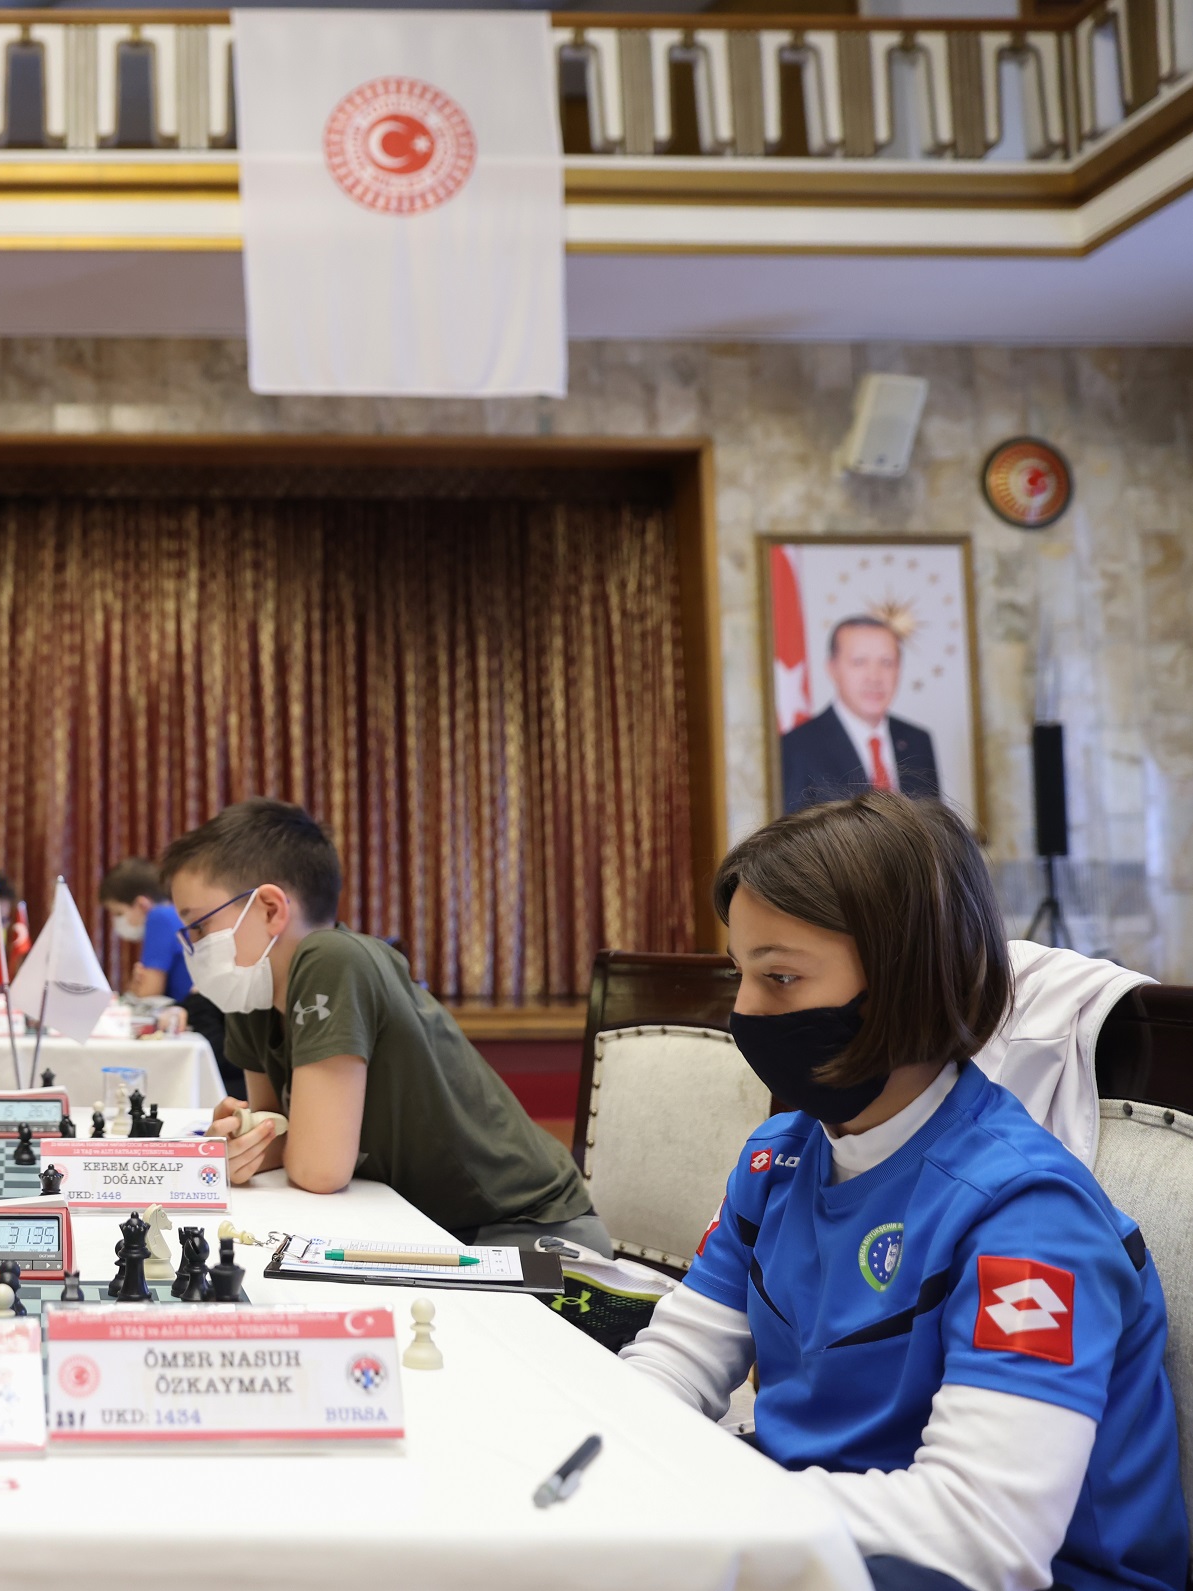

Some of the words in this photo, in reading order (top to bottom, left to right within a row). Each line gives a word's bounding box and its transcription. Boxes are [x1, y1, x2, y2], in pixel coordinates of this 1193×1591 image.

[83, 1162, 130, 1172] KEREM
[132, 1160, 184, 1172] GÖKALP
[103, 1174, 165, 1185] DOĞANAY
[68, 1191, 94, 1200] UKD:
[96, 1191, 122, 1200] 1448
[169, 1190, 221, 1200] İSTANBUL
[8, 1226, 55, 1245] 31.35
[859, 1245, 867, 1266] BURSA
[144, 1347, 217, 1368] ÖMER
[220, 1350, 302, 1368] NASUH
[155, 1373, 295, 1395] ÖZKAYMAK
[100, 1409, 150, 1425] UKD:
[155, 1409, 202, 1425] 1434
[325, 1406, 389, 1423] BURSA
